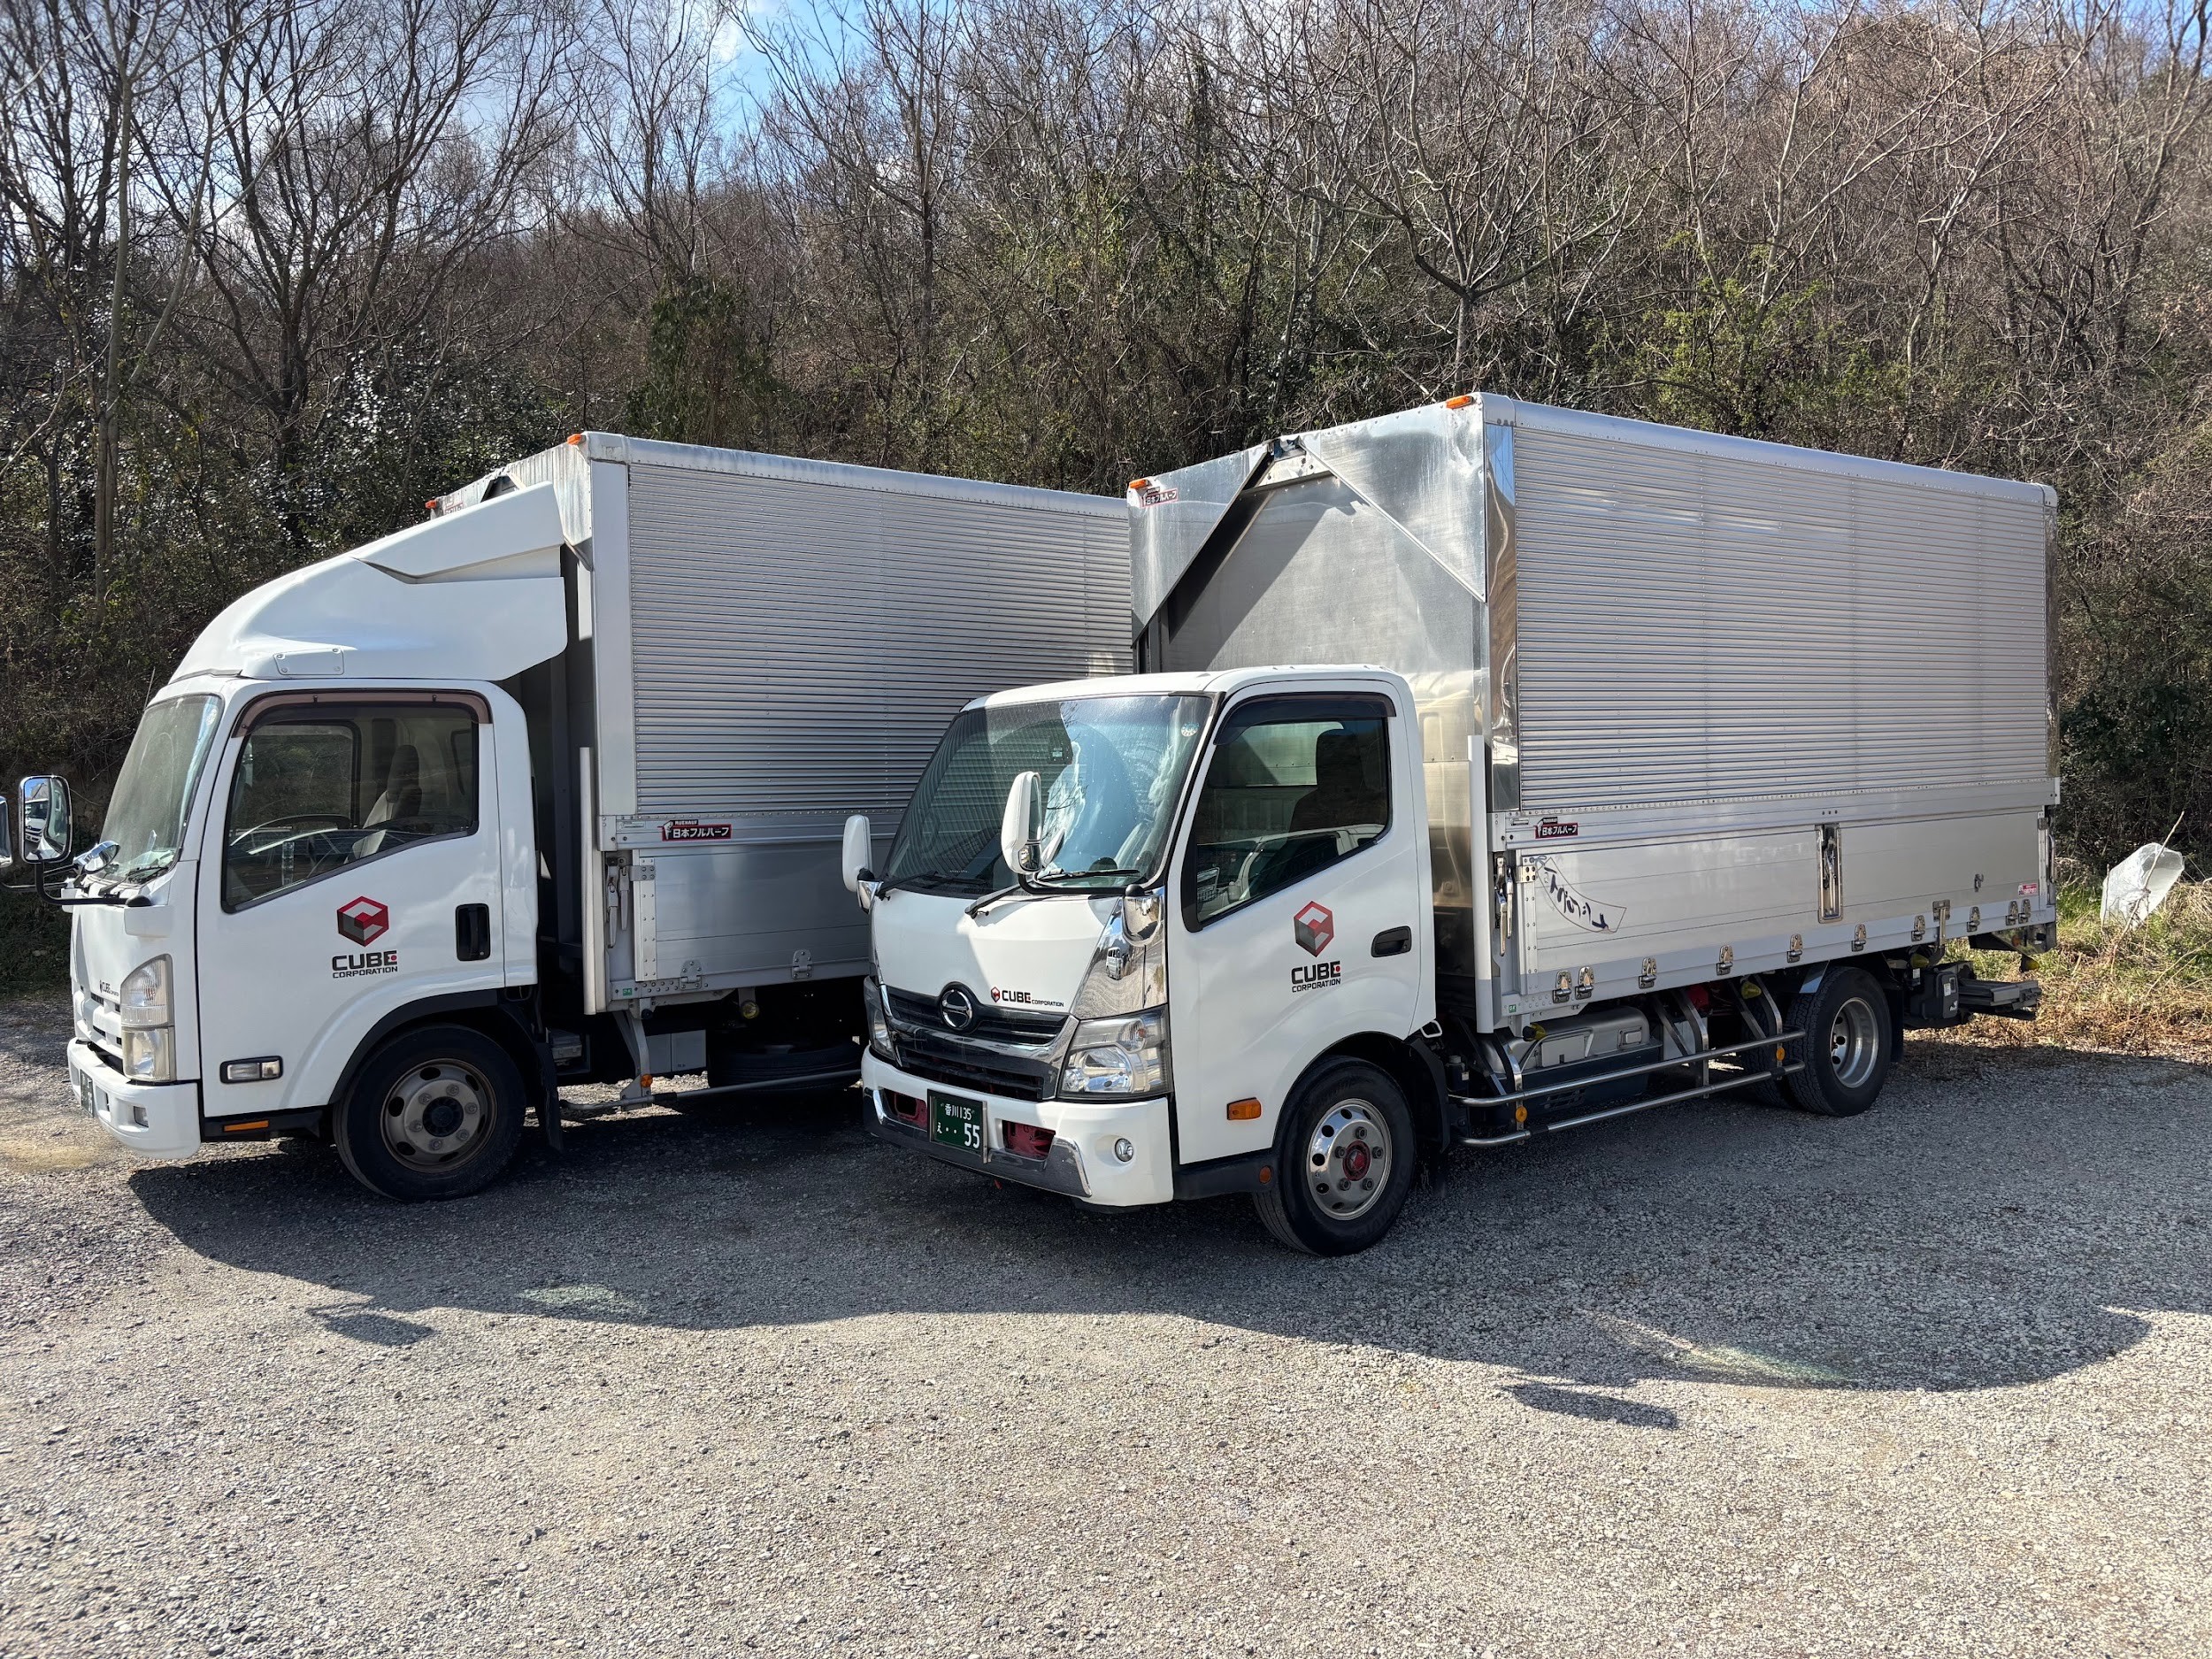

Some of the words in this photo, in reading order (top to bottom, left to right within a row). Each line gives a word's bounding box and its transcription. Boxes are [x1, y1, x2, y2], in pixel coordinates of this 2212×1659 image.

[672, 826, 730, 839] 日本フルハーフ
[1542, 825, 1578, 836] 日本フルハーフ
[332, 950, 398, 972] CUBE
[333, 966, 398, 979] CORPORATION
[1291, 960, 1341, 985] CUBE
[1292, 978, 1341, 993] CORPORATION
[1002, 989, 1032, 1004] CUBE
[1031, 999, 1064, 1008] CORPORATION
